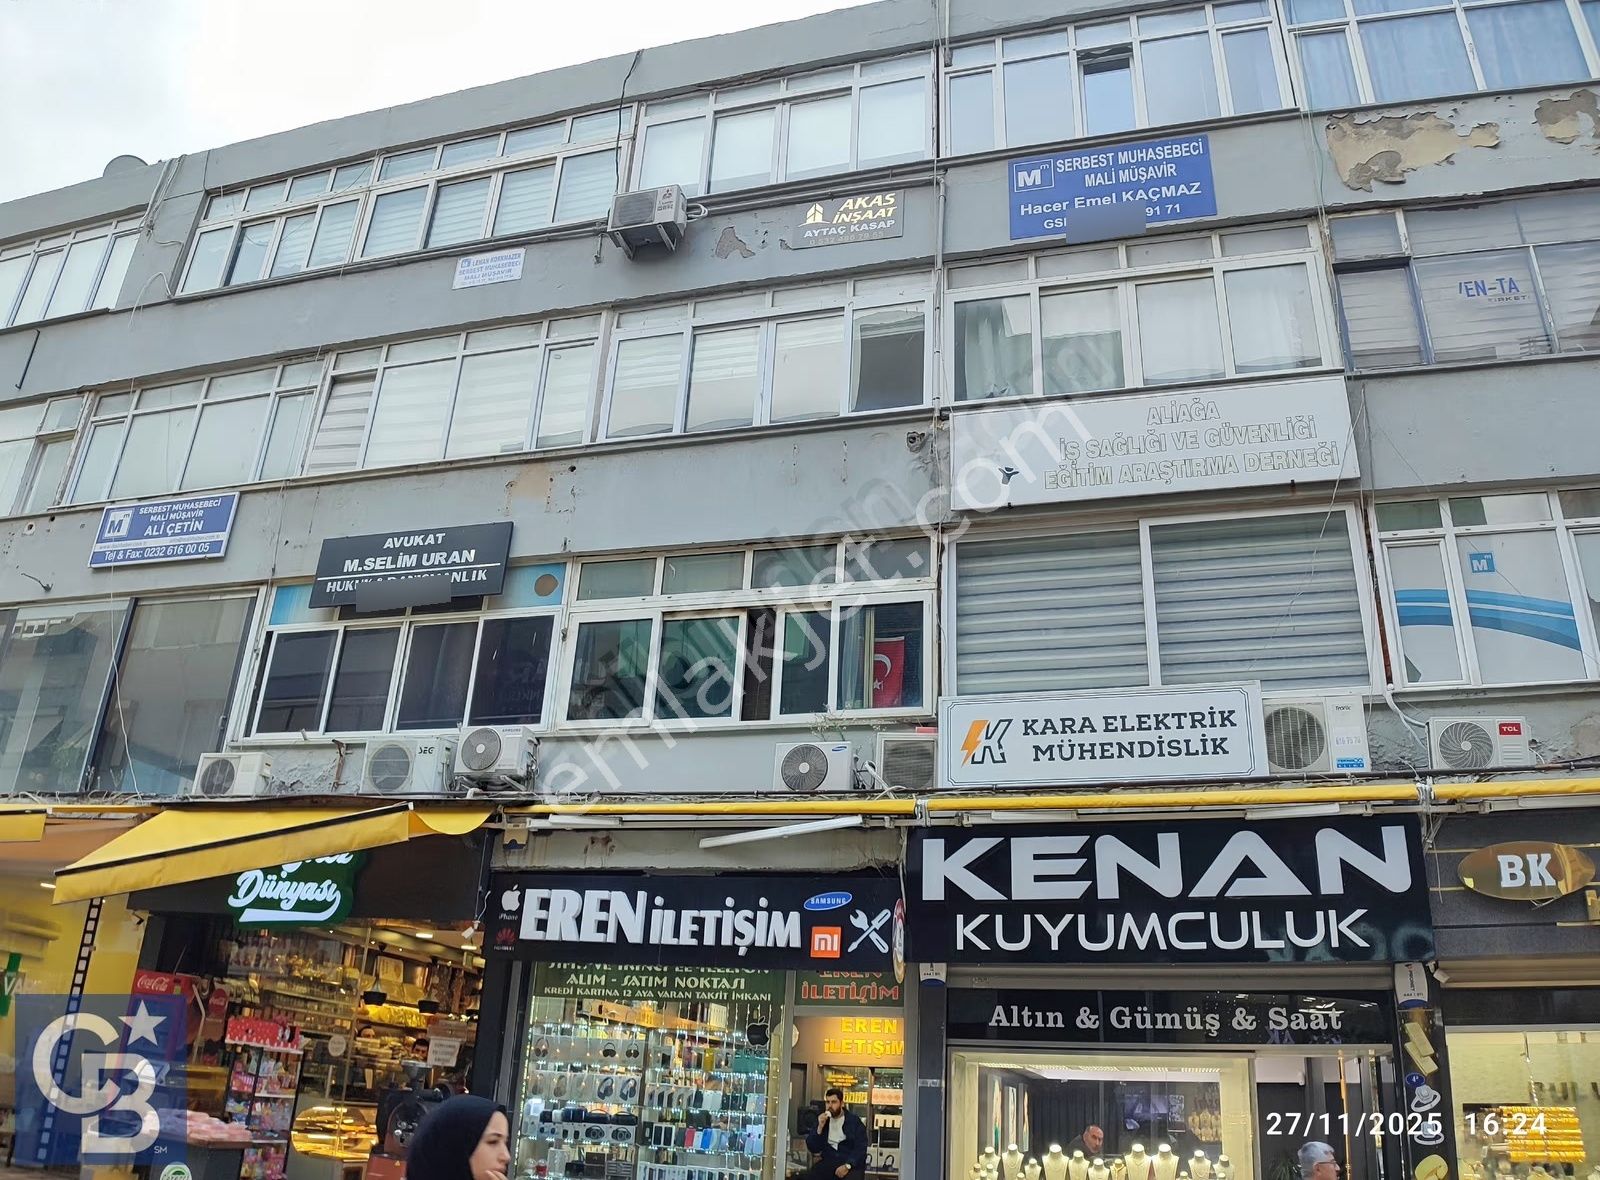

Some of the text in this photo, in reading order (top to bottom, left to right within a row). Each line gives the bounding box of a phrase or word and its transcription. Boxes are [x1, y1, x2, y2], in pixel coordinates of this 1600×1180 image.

[1056, 139, 1203, 173] SERBEST MUHASEBECİ
[1085, 161, 1177, 187] MALİ MÜŞAVİR
[839, 193, 896, 211] AKAS
[1020, 182, 1201, 215] Hacer Emel KAÇMAZ
[832, 207, 897, 224] İNŞAAT
[1044, 218, 1067, 229] GS
[1165, 204, 1180, 214] 71
[804, 220, 895, 238] AYTAÇ KASAP
[1146, 397, 1220, 425] ALİAĞA
[1060, 416, 1317, 463] İŞ SAĞLIĞI VE GÜVENLİĞİ
[1044, 440, 1339, 489] EĞİTİM ARAŞTIRMA DERNEĞİ
[139, 498, 221, 514] SERBEST MUHASEBECİ
[150, 509, 204, 522] MALİ MÜŞAVİR
[144, 521, 204, 536] ALİ ÇETİN
[383, 533, 445, 549] AVUKAT
[104, 543, 210, 561] Tel & Fax: 0232 616 00 05
[344, 550, 475, 572] M.SELİM URAN
[1022, 716, 1097, 736] KARA
[1103, 705, 1237, 732] ELEKTRİK
[1033, 733, 1230, 762] MÜHENDİSLİK
[922, 826, 1412, 900] KENAN
[1497, 854, 1557, 888] BK
[228, 869, 341, 910] Dünyası
[810, 896, 848, 906] SAMSUNG
[519, 889, 801, 956] EREN İLETİŞİM
[956, 909, 1370, 951] KUYUMCULUK
[544, 986, 772, 1001] KREDİ KARTINA 12 AYA VARAN TAKSİT İMKANI
[566, 974, 606, 985] ALIM
[621, 975, 668, 987] SATIM
[675, 977, 745, 989] NOKTASI
[801, 981, 899, 1003] İLETİŞİM
[841, 1018, 897, 1034] EREN
[988, 1005, 1342, 1037] Altın & Gümüş & Saat
